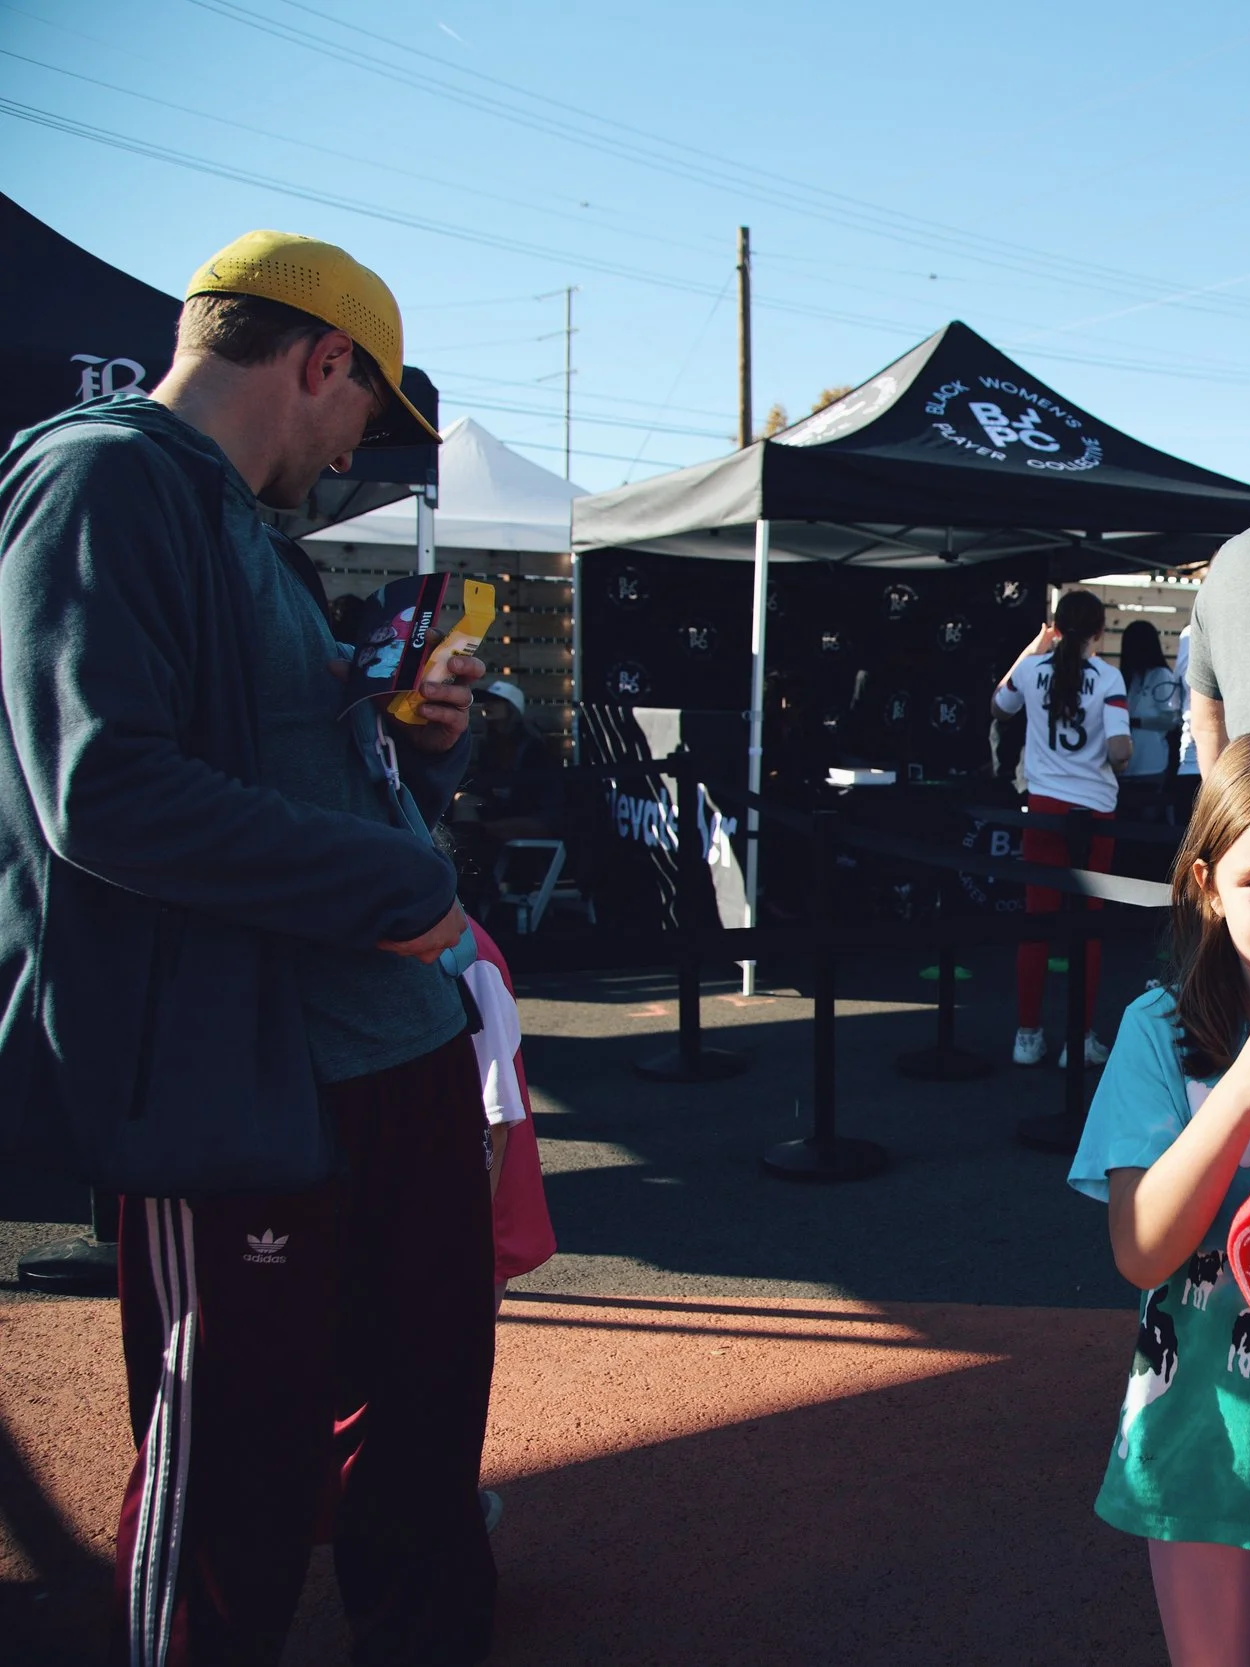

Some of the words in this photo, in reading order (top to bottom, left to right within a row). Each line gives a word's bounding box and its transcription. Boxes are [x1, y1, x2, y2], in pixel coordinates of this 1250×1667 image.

[924, 379, 971, 416] BLACK
[977, 375, 1083, 429] WOMEN'S
[931, 422, 1008, 462] PLAYER
[1026, 436, 1104, 472] COLLECTIVE
[412, 611, 433, 649] Canon
[1042, 704, 1087, 751] 13
[243, 1253, 288, 1264] adidas
